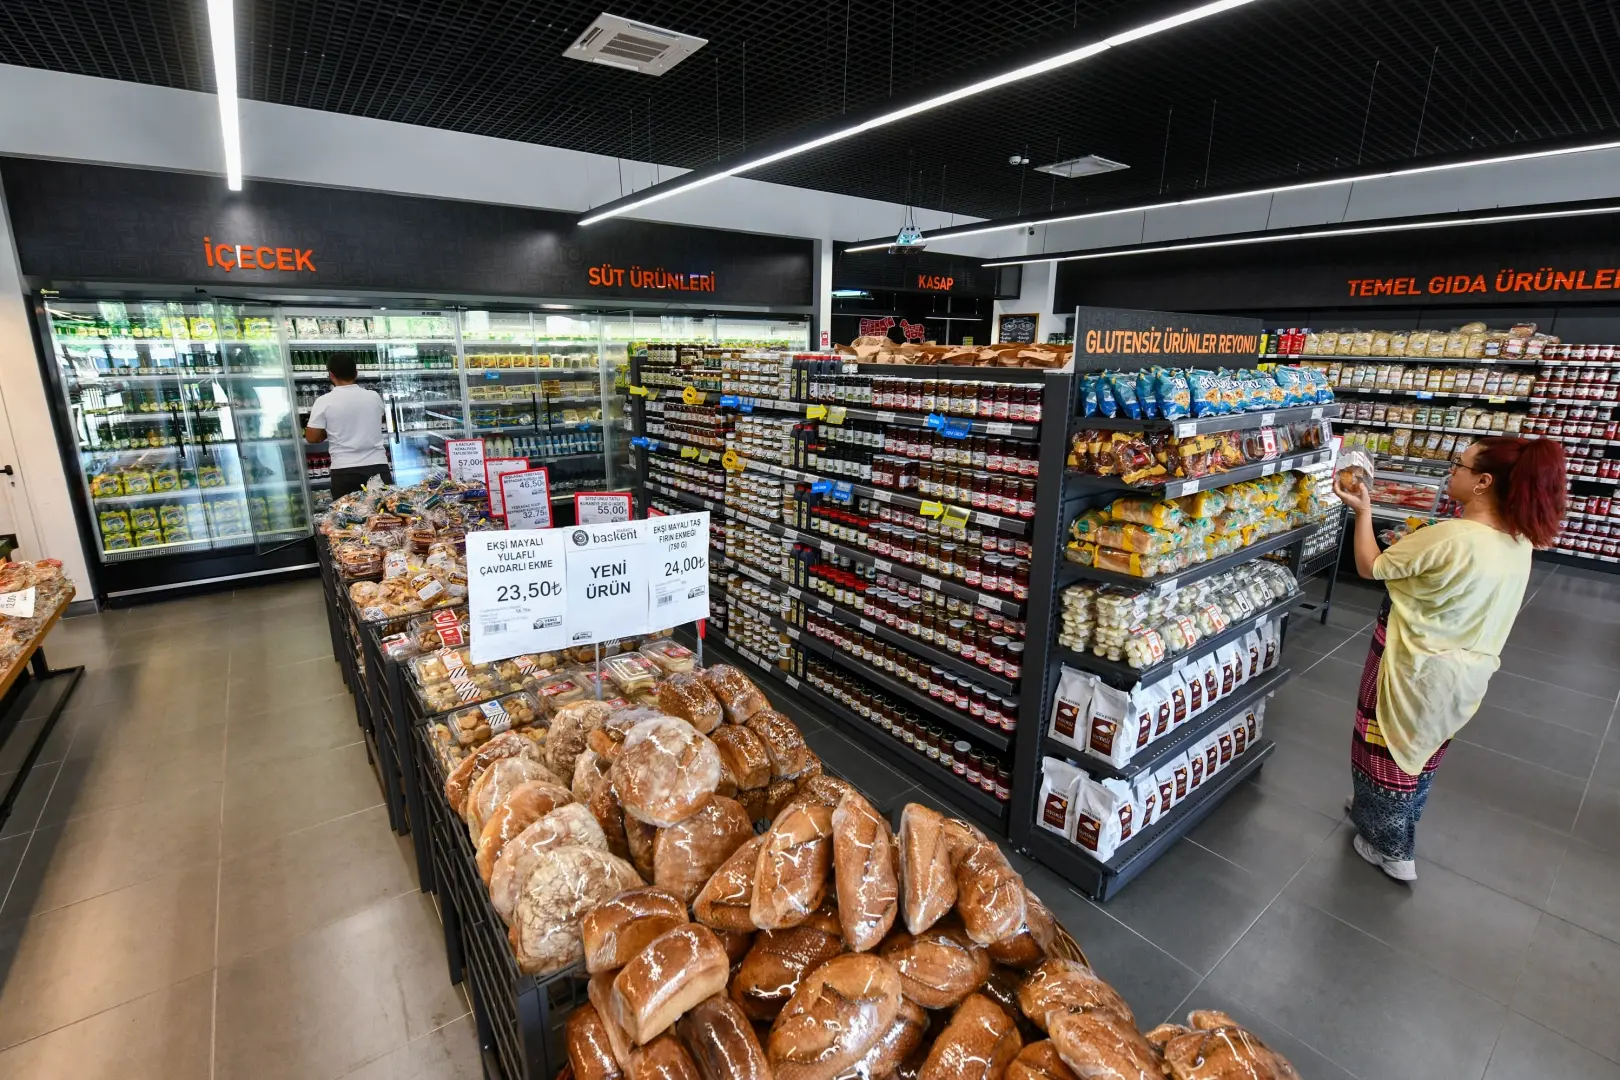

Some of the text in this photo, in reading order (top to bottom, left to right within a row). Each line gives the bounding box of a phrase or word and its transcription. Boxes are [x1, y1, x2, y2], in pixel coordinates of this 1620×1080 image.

[203, 236, 316, 272] İÇECEK
[588, 263, 715, 292] SÜT ÜRÜNLERİ
[918, 274, 954, 290] KASAP
[1348, 277, 1421, 297] TEMEL
[1428, 275, 1487, 295] GIDA
[1085, 326, 1257, 354] GLUTENSİZ ÜRÜNLER REYONU
[653, 518, 701, 535] EKŞİ MAYALI TAŞ
[486, 537, 544, 551] EKŞİ MAYALI
[659, 534, 674, 543] FIRIN
[498, 550, 535, 562] YULAFLI
[480, 559, 553, 577] ÇAVDARLI EKME
[590, 559, 626, 579] YENİ
[664, 556, 706, 577] 24,00₺
[496, 581, 562, 602] 23,50₺
[586, 580, 631, 599] ÜRÜN
